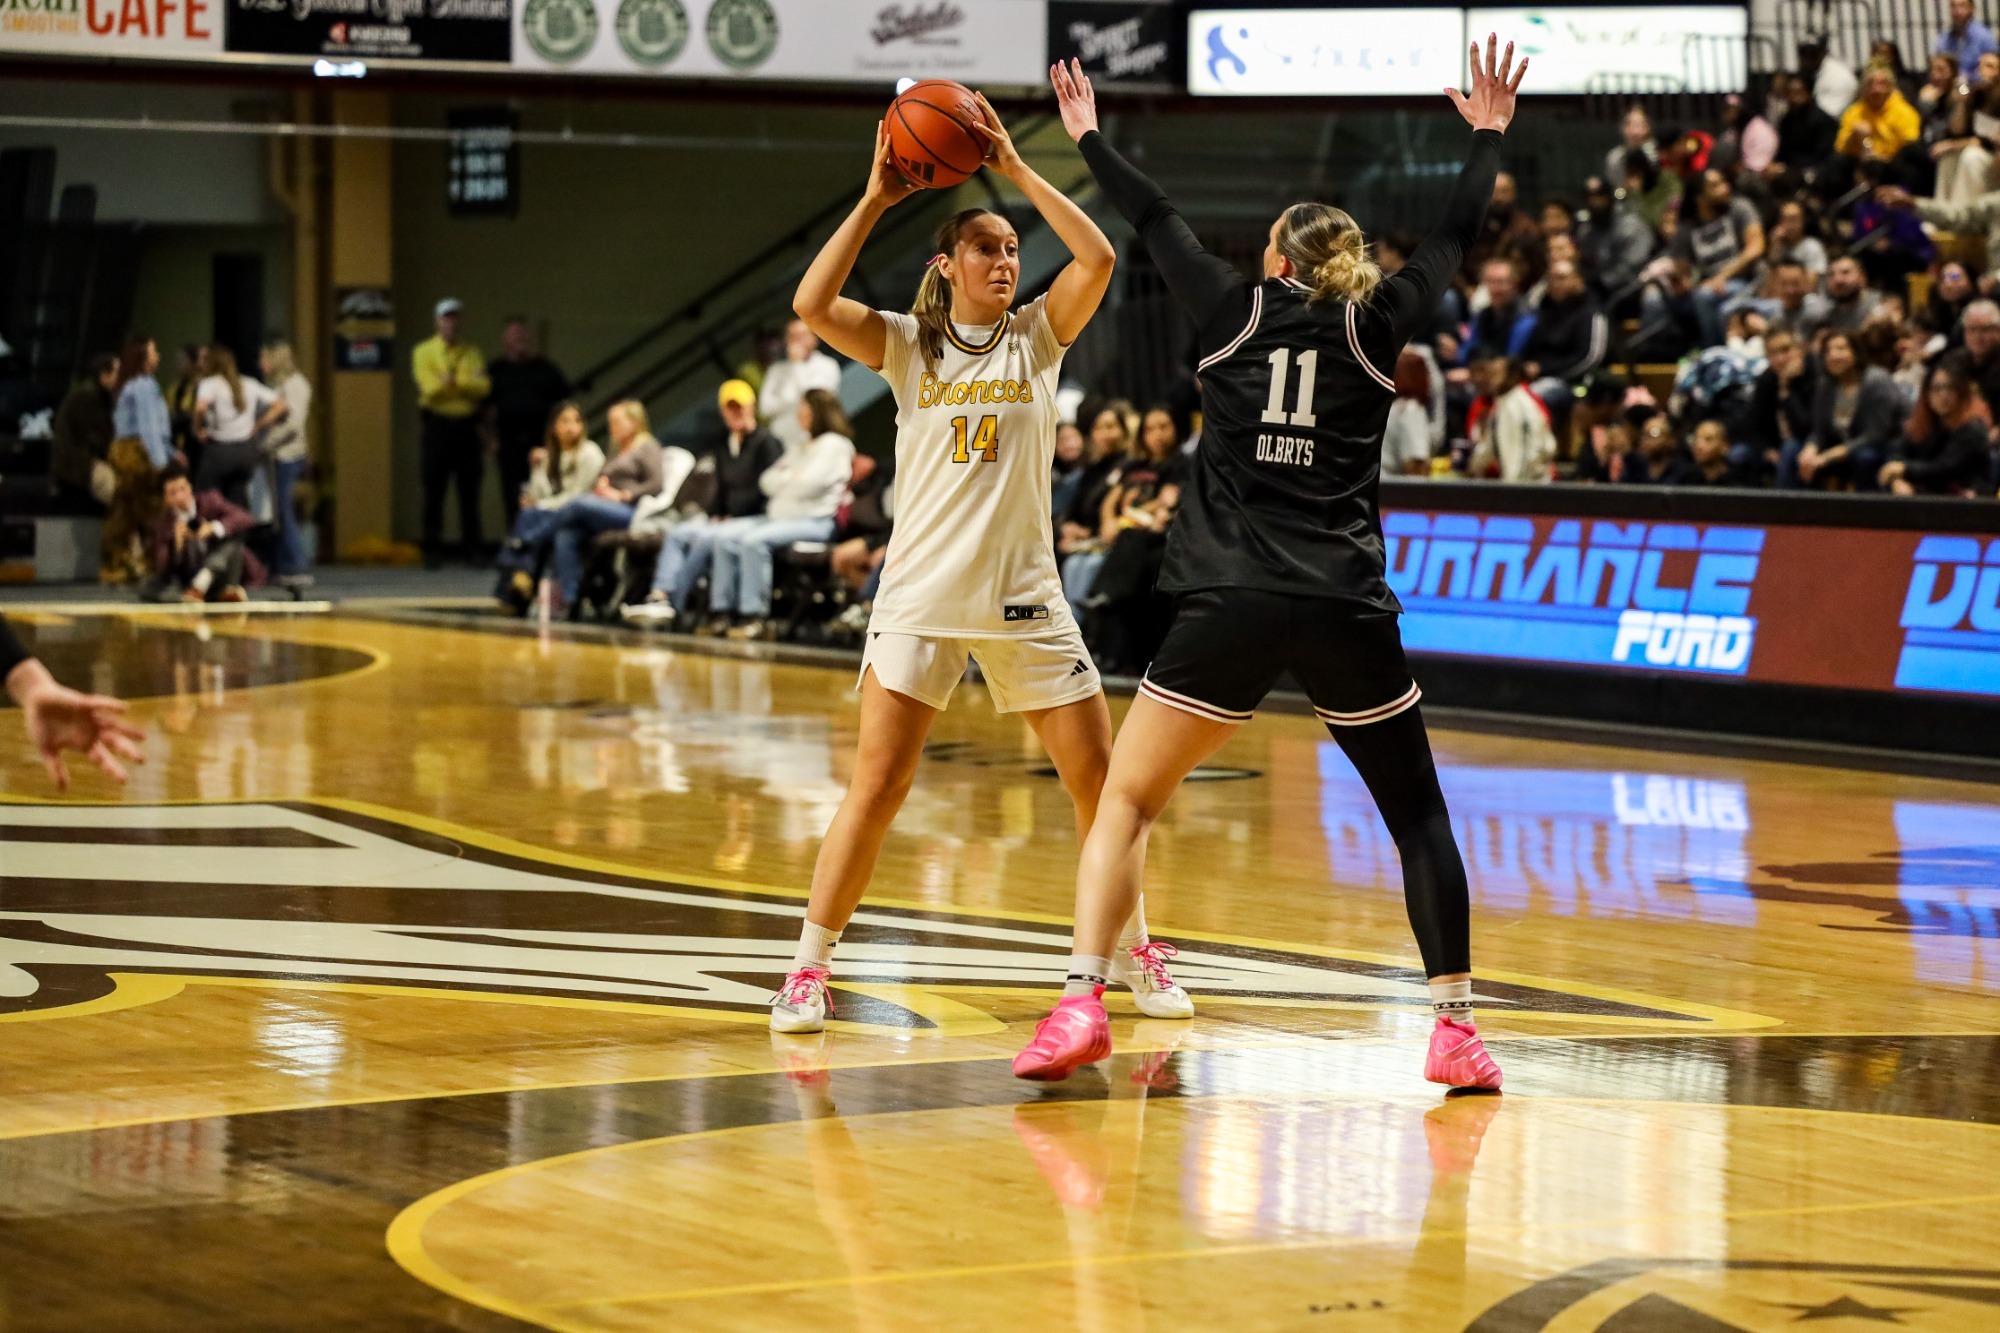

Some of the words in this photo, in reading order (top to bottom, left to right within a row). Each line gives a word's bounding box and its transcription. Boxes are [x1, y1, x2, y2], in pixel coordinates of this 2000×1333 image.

[918, 371, 1034, 409] Broncos
[1261, 347, 1318, 428] 11
[951, 414, 999, 464] 14
[1256, 433, 1315, 467] OLBRYS
[1383, 511, 1766, 616] ORRANCE
[1611, 608, 1753, 670] FORD
